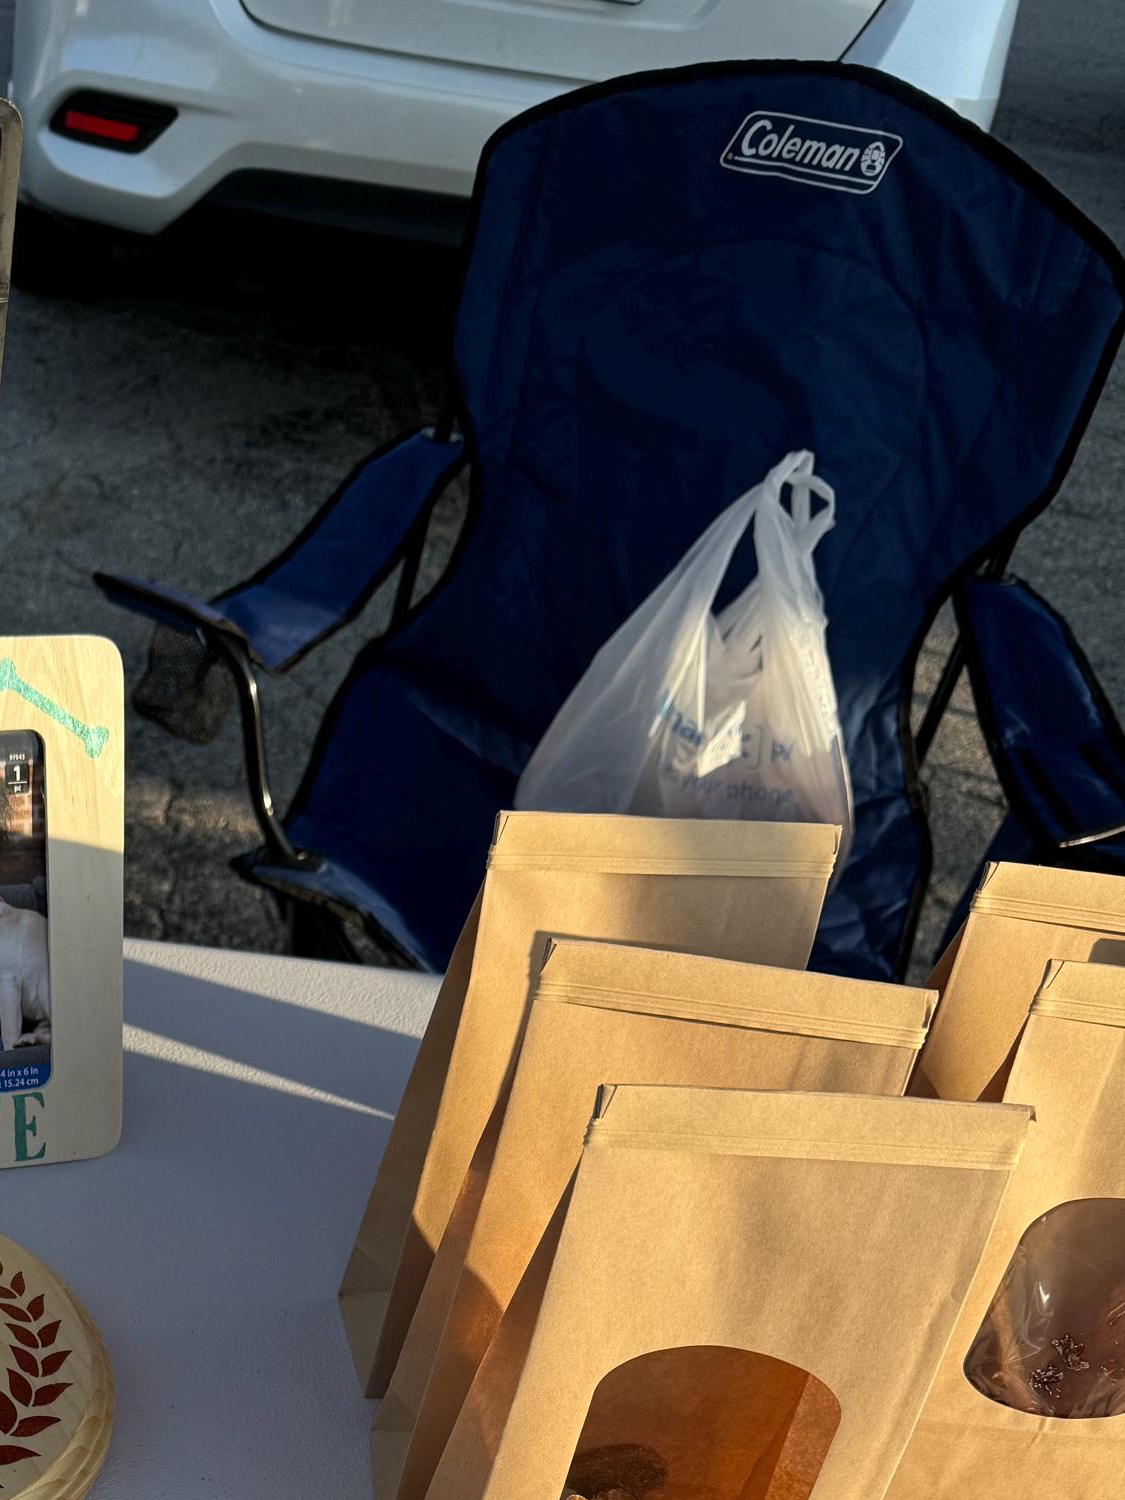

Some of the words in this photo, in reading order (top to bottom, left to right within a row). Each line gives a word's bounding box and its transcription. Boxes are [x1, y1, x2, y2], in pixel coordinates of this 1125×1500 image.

[741, 118, 860, 172] Coleman
[13, 764, 21, 782] 1
[13, 785, 22, 793] pc
[0, 1069, 6, 1079] 4
[7, 1068, 16, 1078] in
[23, 1068, 29, 1076] 6
[30, 1066, 39, 1076] in
[4, 1077, 25, 1088] 15.24
[27, 1077, 39, 1086] cm
